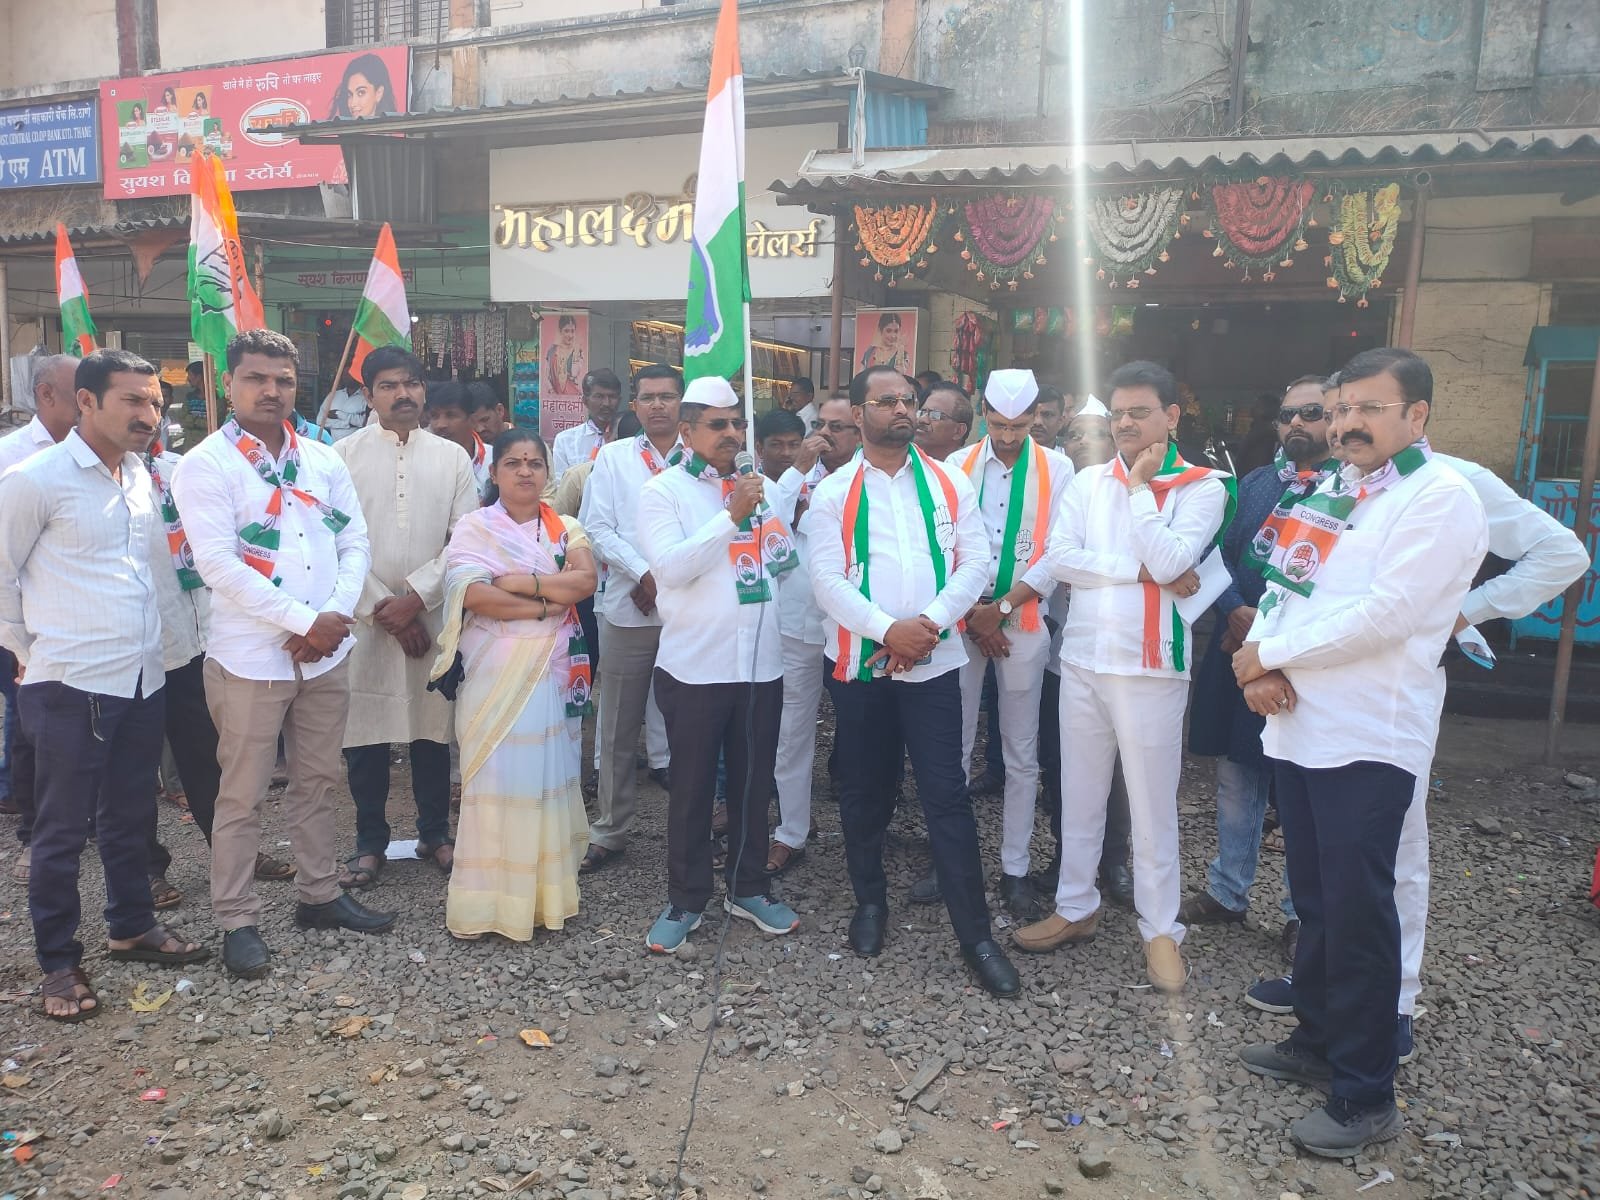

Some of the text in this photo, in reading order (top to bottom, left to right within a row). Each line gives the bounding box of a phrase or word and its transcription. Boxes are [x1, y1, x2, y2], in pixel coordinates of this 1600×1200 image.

[8, 158, 30, 183] एम
[40, 147, 86, 178] ATM
[120, 175, 166, 194] सुयश
[245, 161, 293, 180] स्टोर्स
[745, 218, 825, 258] वेलर्स
[1300, 510, 1339, 531] CONGRESS
[240, 542, 271, 559] CONGRESS
